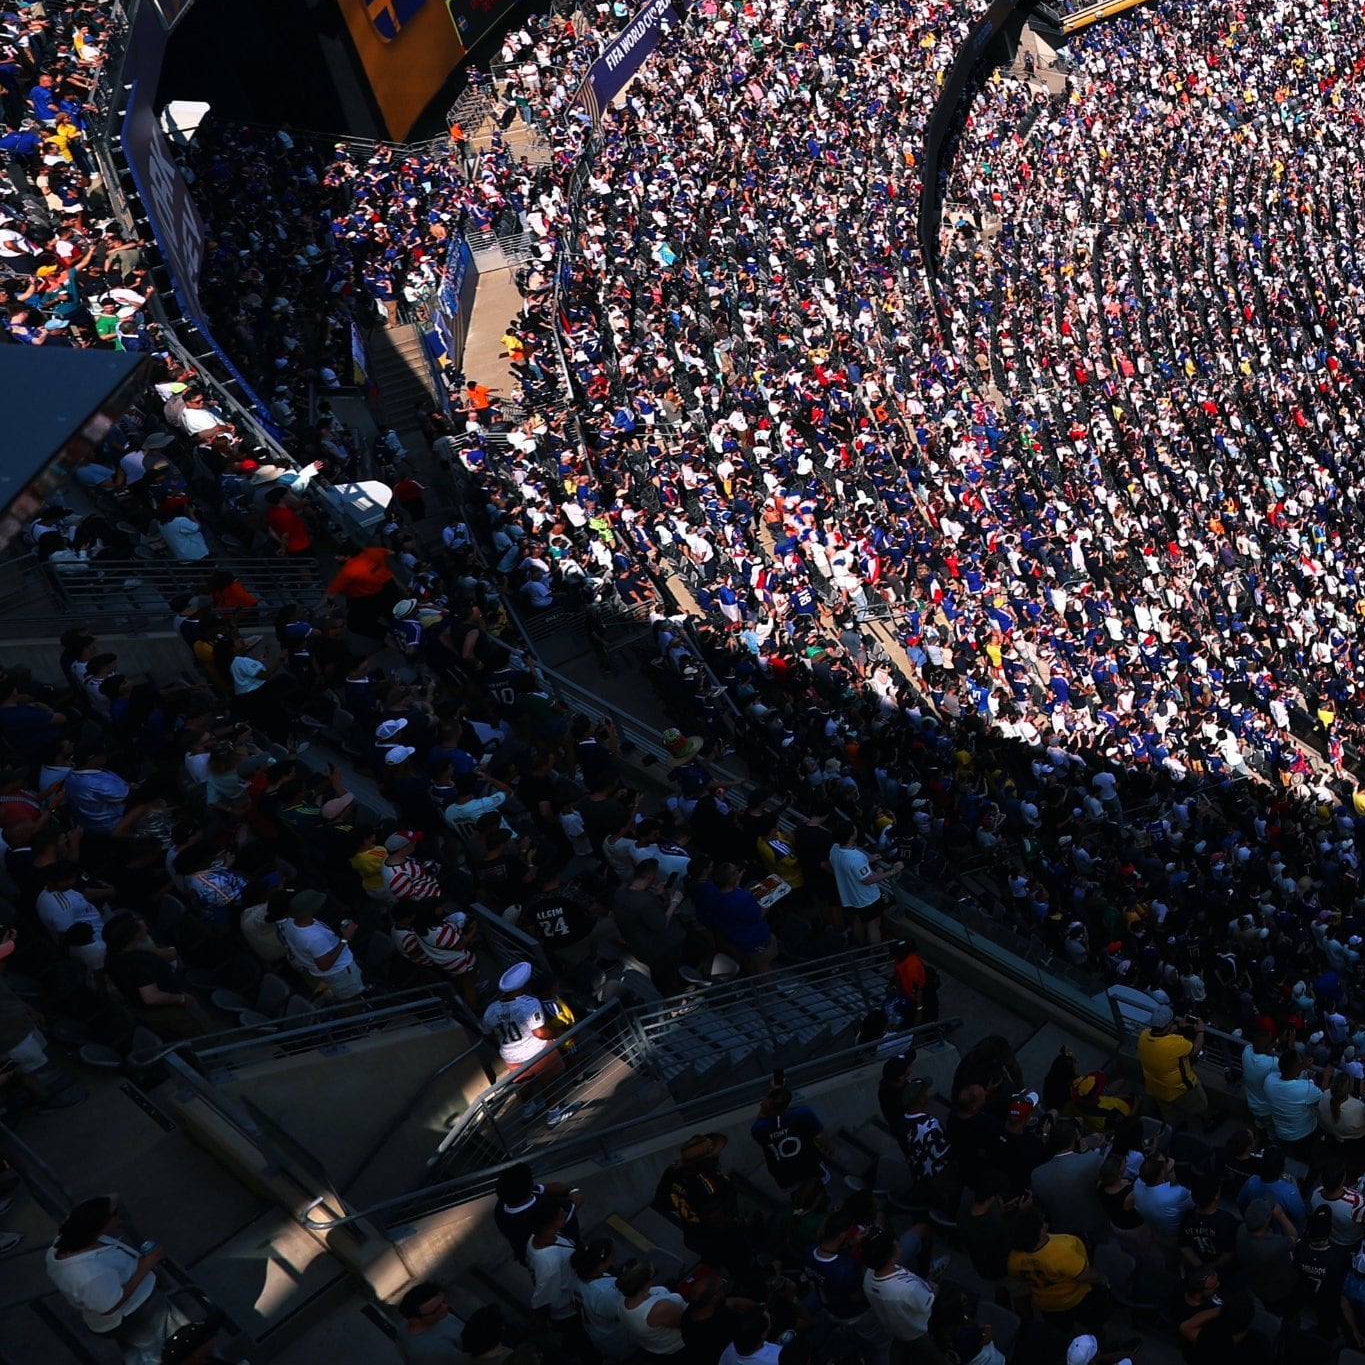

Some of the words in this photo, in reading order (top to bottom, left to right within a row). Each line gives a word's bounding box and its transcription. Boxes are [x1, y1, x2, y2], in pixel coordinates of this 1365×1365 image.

[605, 50, 625, 72] FIFA
[619, 21, 647, 54] WORLD
[489, 687, 515, 706] 10
[538, 916, 571, 938] 24
[768, 1126, 789, 1141] TONY
[767, 1136, 801, 1163] 10
